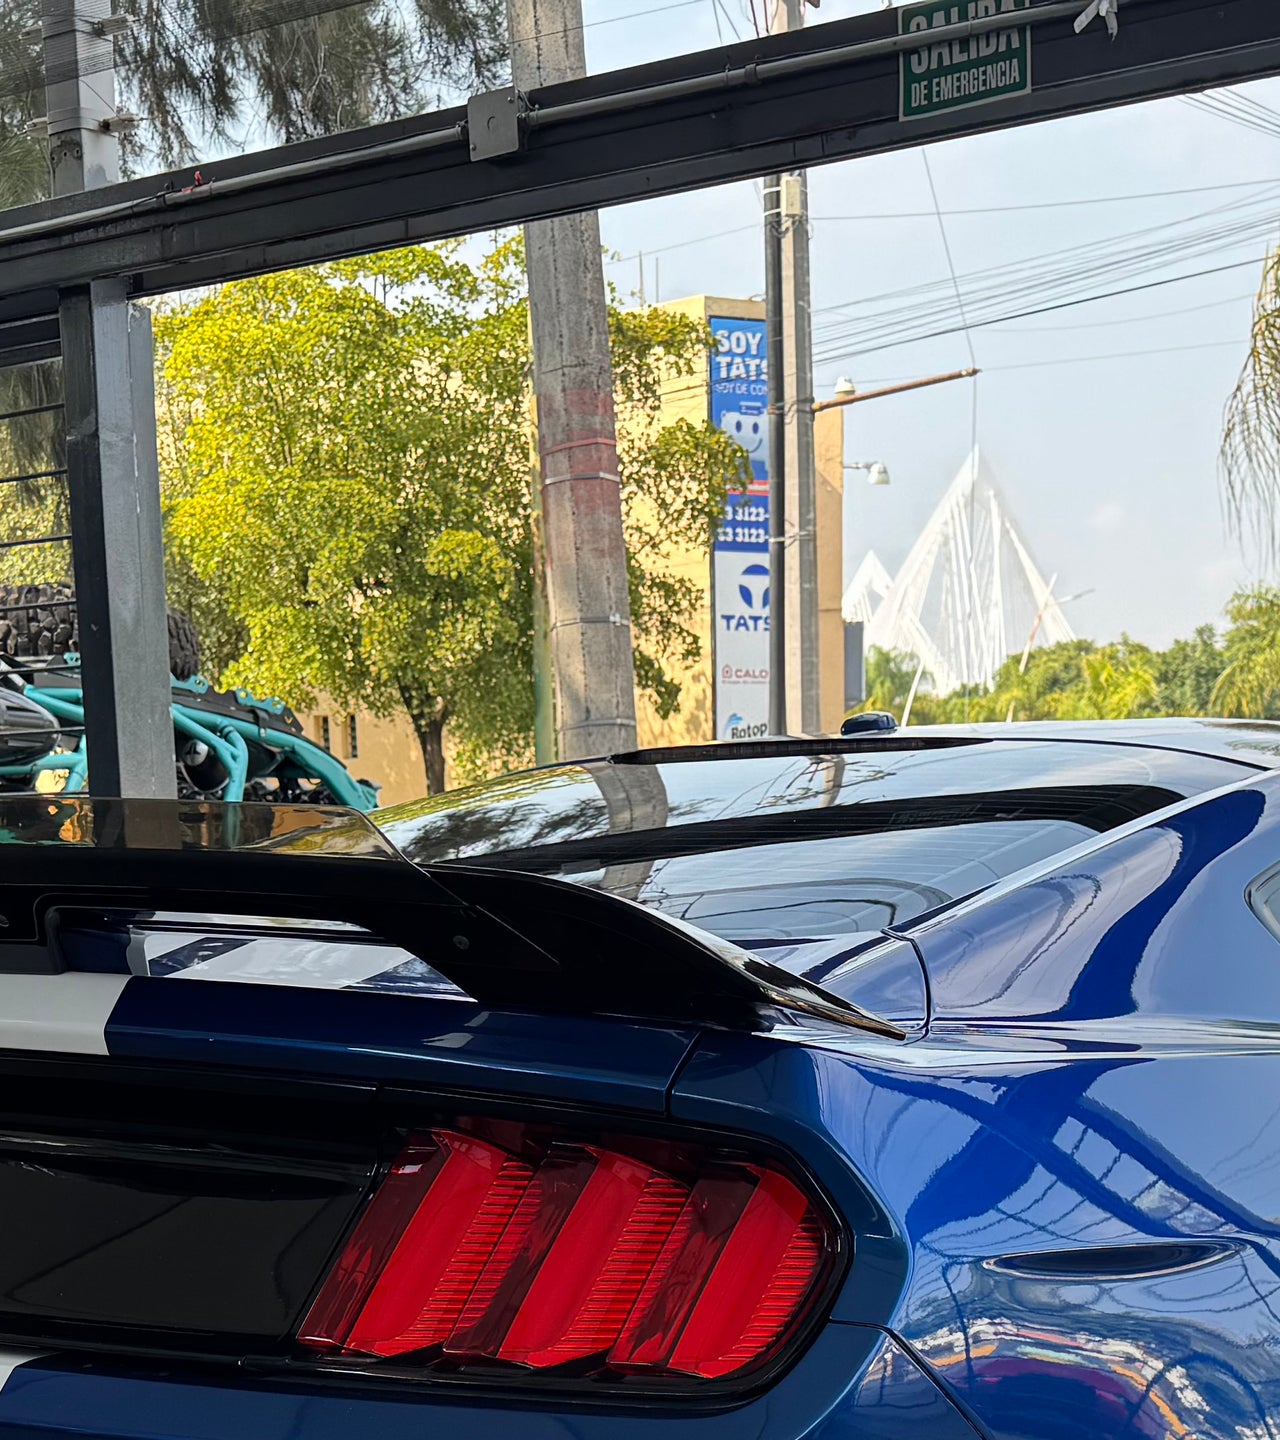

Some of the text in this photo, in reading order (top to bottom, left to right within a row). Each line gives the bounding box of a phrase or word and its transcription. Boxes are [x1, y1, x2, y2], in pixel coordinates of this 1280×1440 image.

[911, 58, 1020, 108] DE EMERGENCIA
[715, 330, 762, 355] SOY
